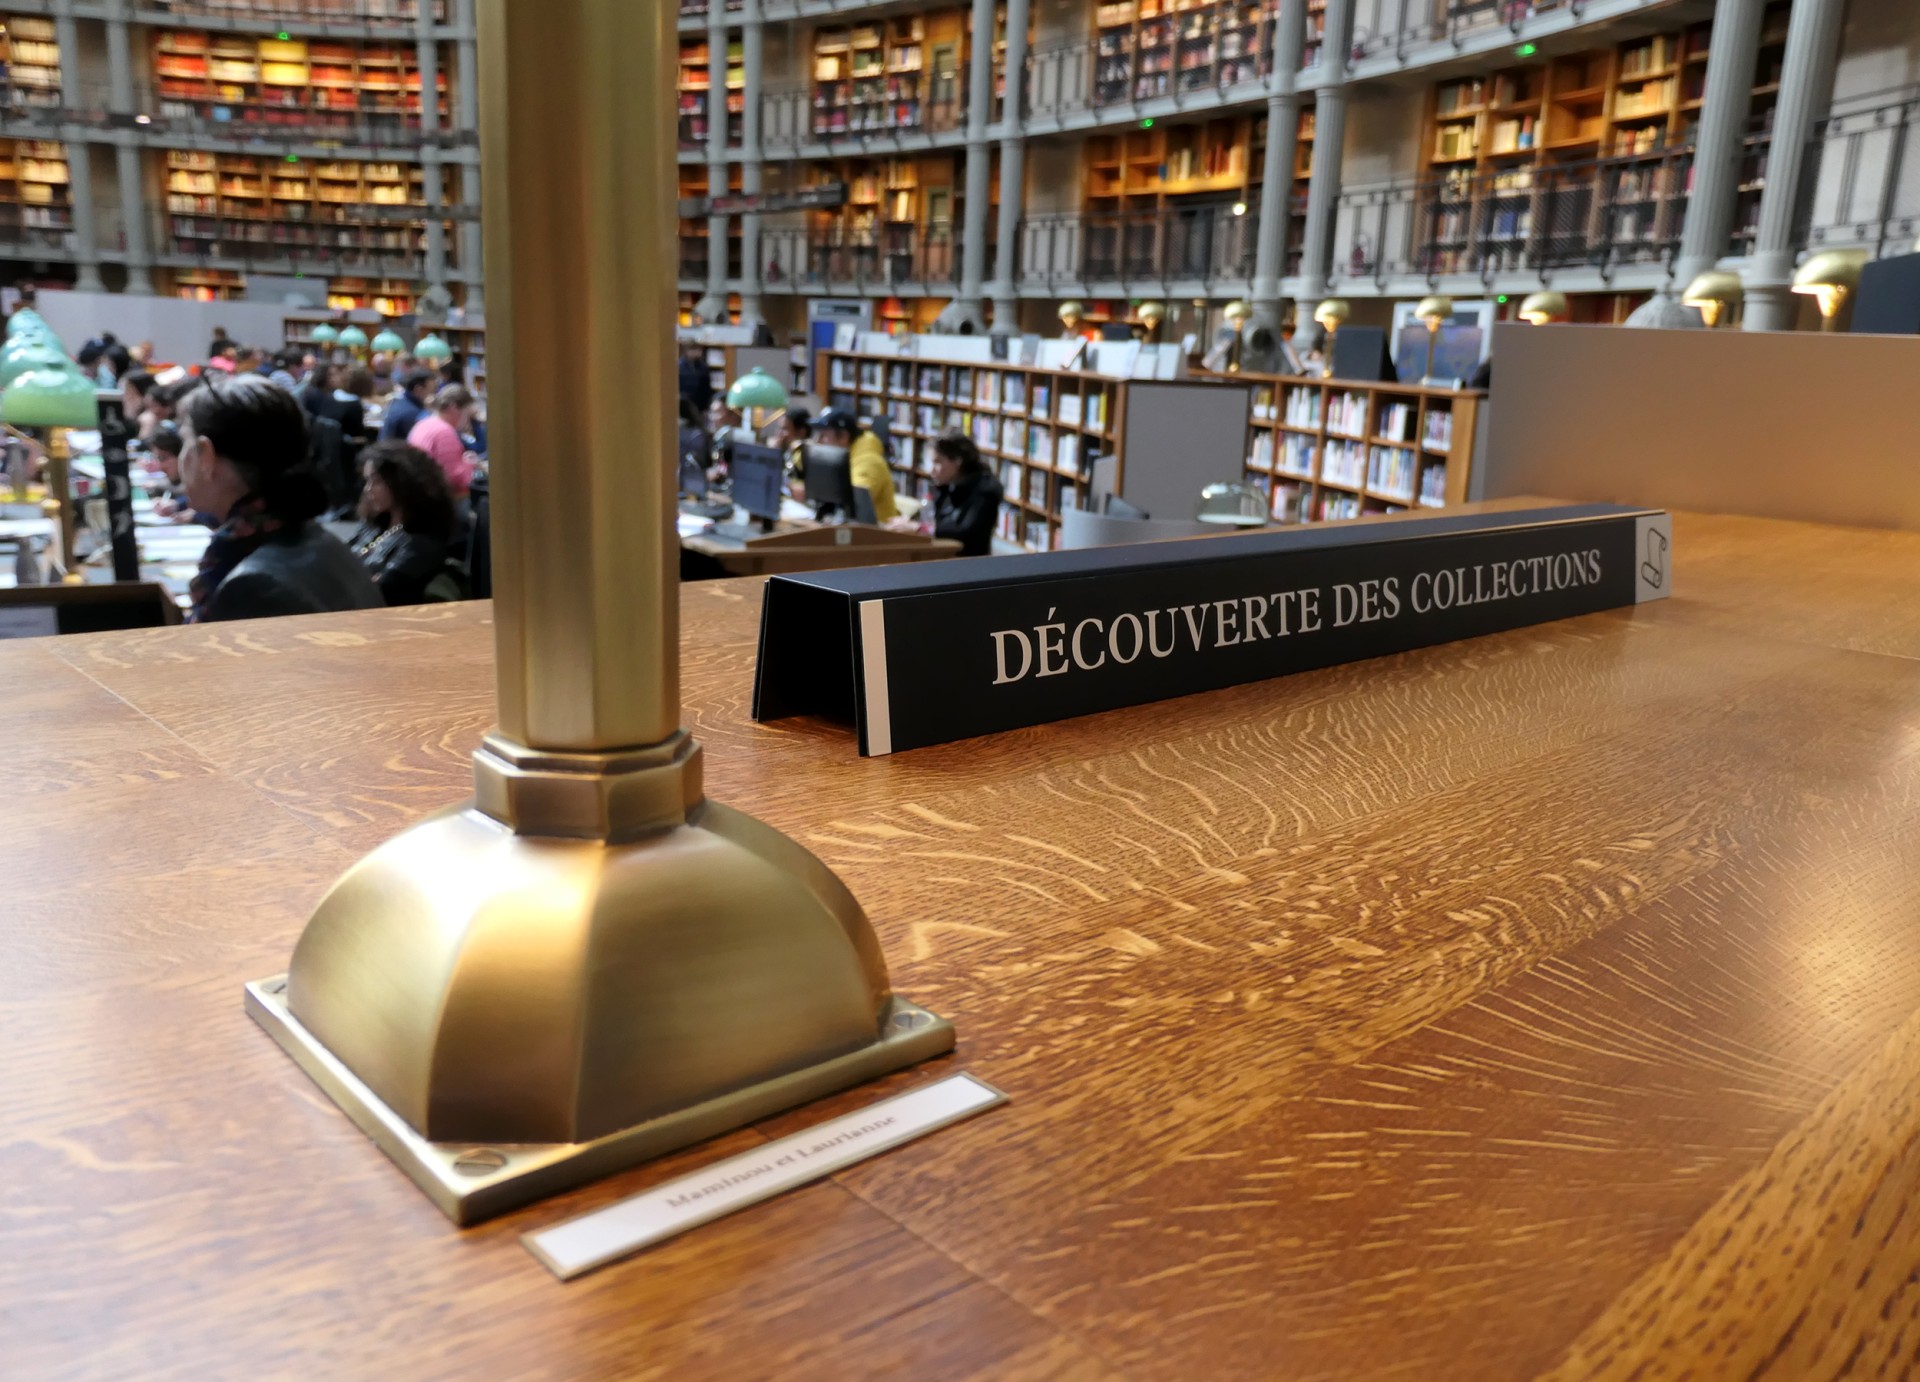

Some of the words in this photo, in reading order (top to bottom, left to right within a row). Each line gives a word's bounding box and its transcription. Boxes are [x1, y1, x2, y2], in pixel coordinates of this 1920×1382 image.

[989, 588, 1322, 685] DÉCOUVERTE
[1332, 577, 1400, 627] DES
[1410, 549, 1602, 613] COLLECTIONS
[776, 1154, 796, 1168] et
[796, 1115, 897, 1158] Laurianne
